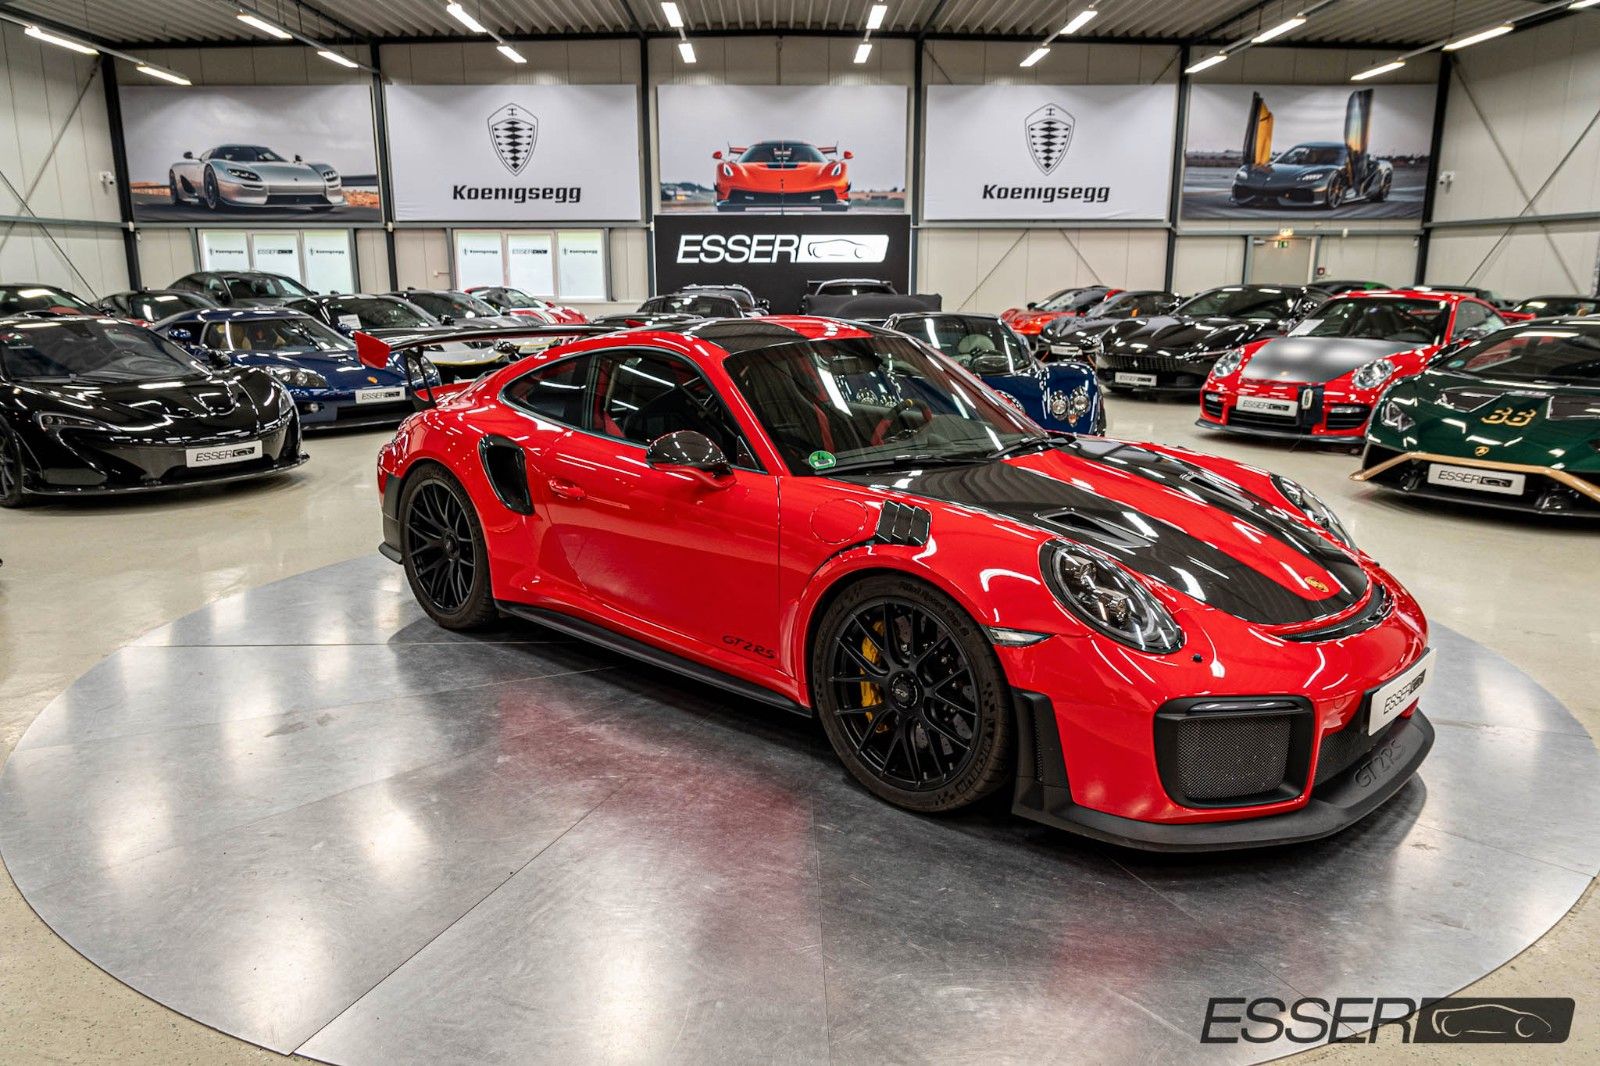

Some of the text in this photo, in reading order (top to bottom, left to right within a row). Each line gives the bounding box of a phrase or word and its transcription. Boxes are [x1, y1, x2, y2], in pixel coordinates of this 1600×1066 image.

[452, 184, 582, 203] Koenigsegg
[982, 184, 1110, 203] Koenigsegg
[676, 234, 799, 264] ESSER
[1243, 399, 1269, 409] ESSER
[195, 449, 232, 462] ESSER
[1438, 470, 1481, 484] ESSER
